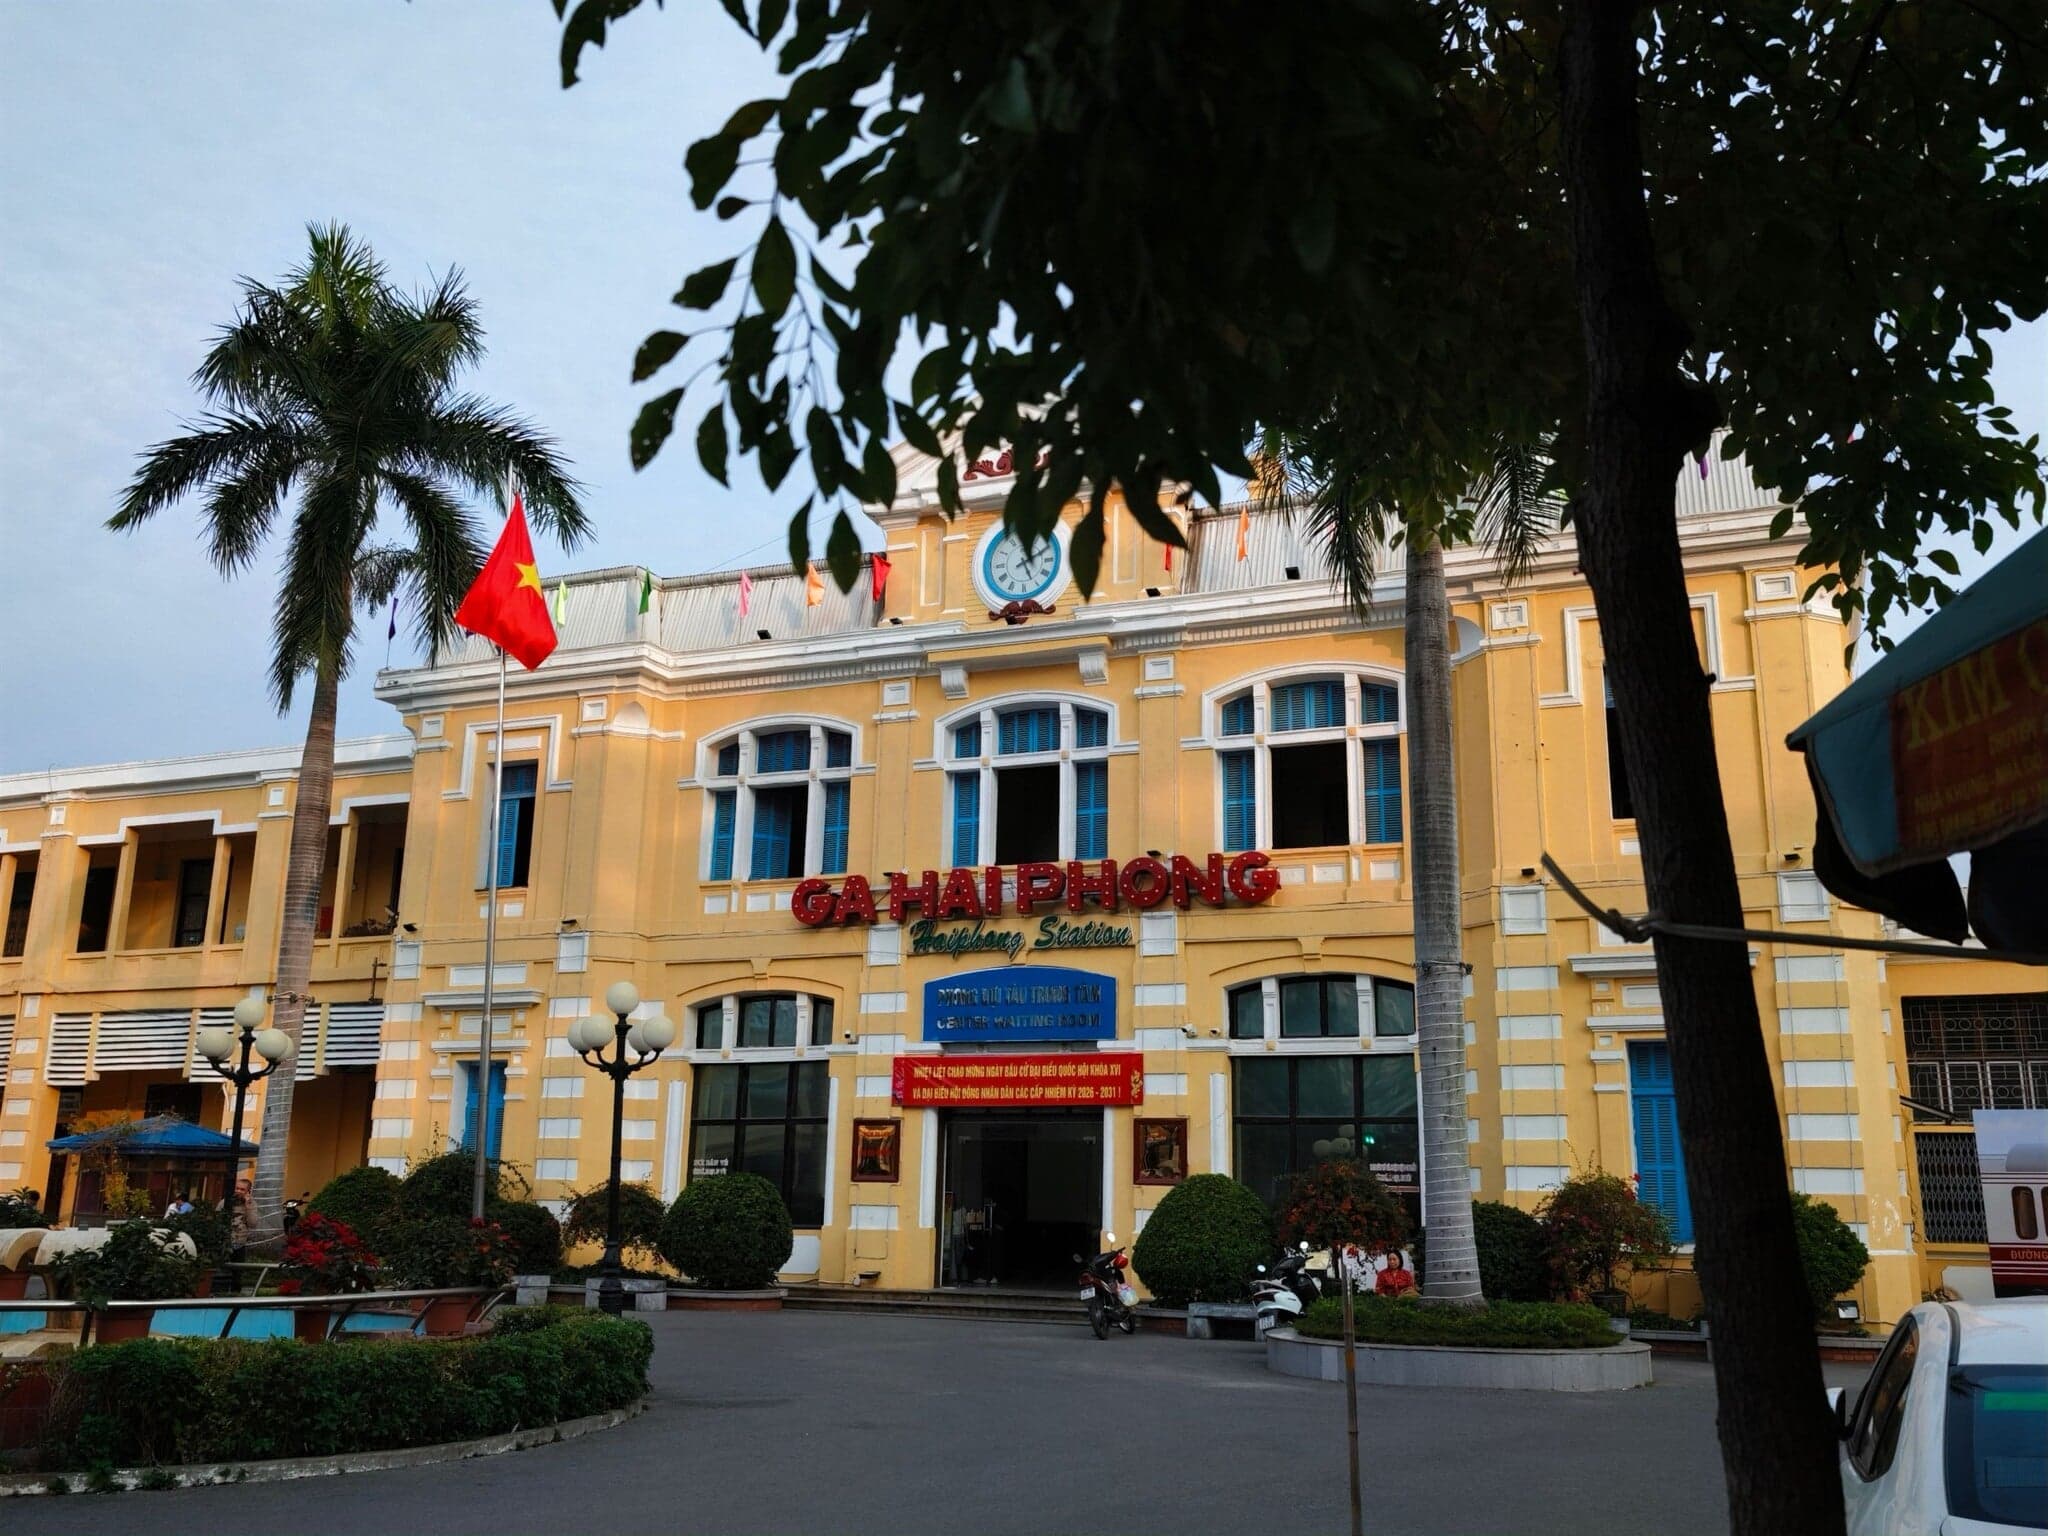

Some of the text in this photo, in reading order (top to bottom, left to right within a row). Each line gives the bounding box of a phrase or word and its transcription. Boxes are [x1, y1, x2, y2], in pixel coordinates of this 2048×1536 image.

[791, 851, 1282, 925] GA HAI PHONG
[910, 914, 1133, 961] Haiphong Station
[937, 1016, 988, 1030] CENTER
[994, 1014, 1053, 1030] WAITING
[1110, 1063, 1121, 1076] XVI
[1078, 1086, 1094, 1098] 2026
[1100, 1086, 1116, 1098] 2031
